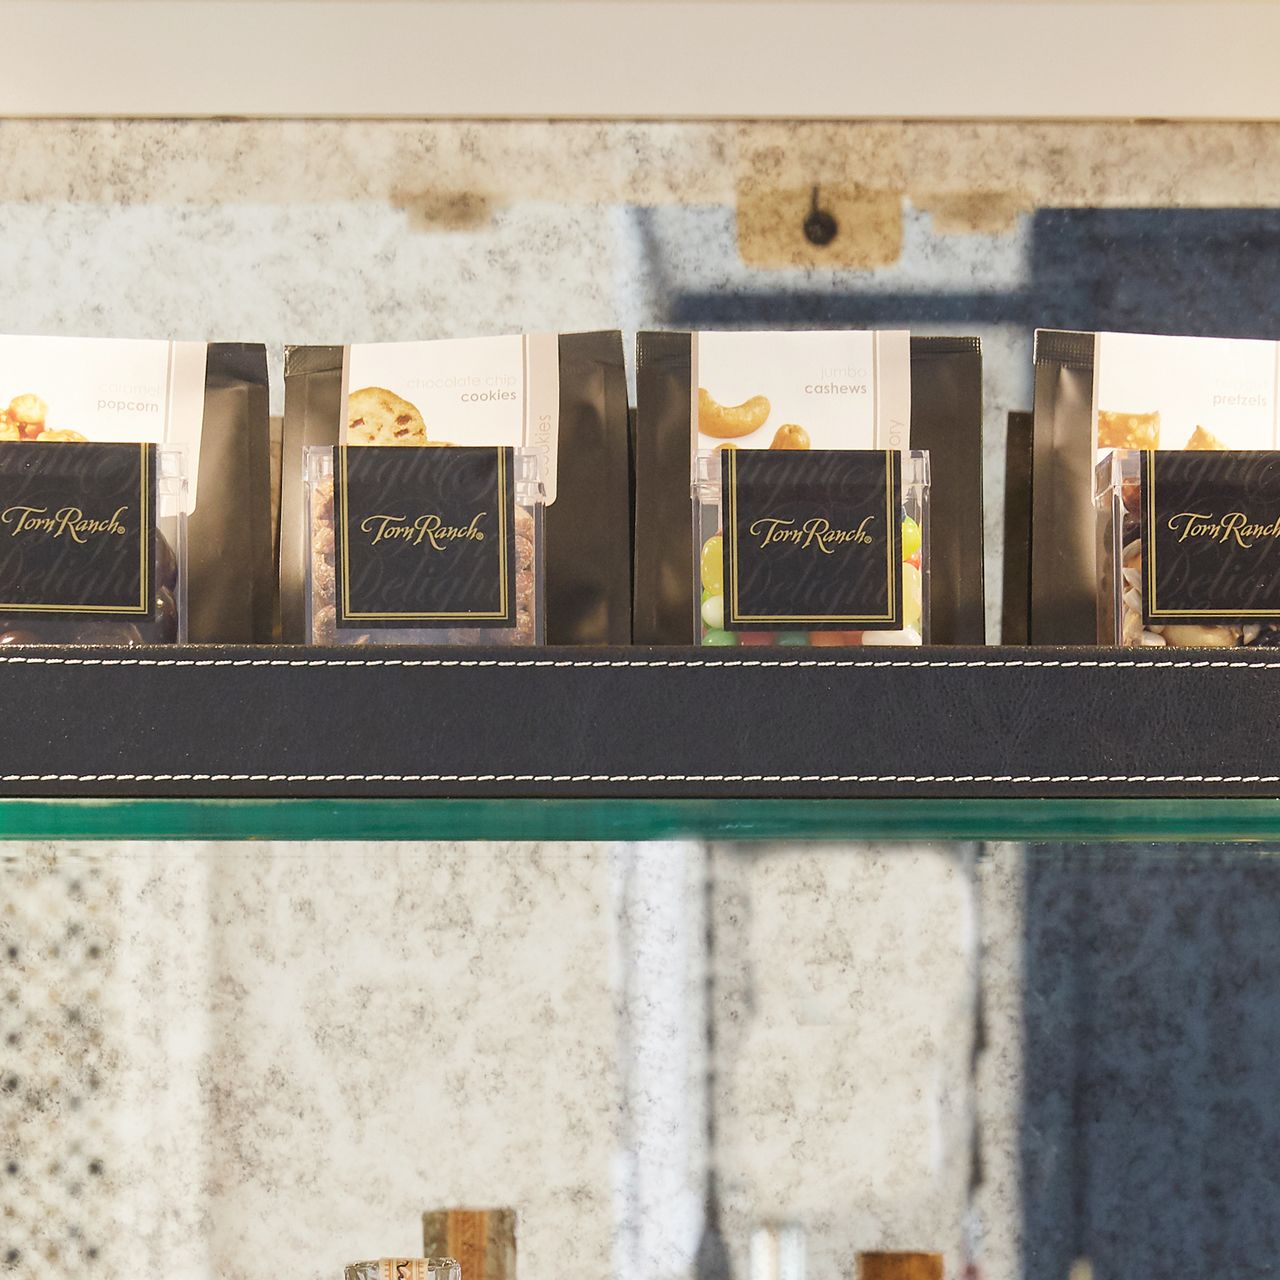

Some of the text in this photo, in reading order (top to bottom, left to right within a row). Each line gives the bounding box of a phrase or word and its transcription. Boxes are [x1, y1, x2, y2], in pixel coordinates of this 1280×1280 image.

[820, 365, 867, 380] jumbo
[407, 375, 517, 389] chocolate chip
[804, 383, 867, 394] cashews
[461, 390, 517, 402] cookies
[1213, 394, 1267, 407] pretzels
[97, 399, 159, 413] popcorn
[1, 506, 53, 536] Torn
[1168, 512, 1221, 543] Torn
[361, 514, 415, 546] Torn
[750, 518, 803, 549] Torn
